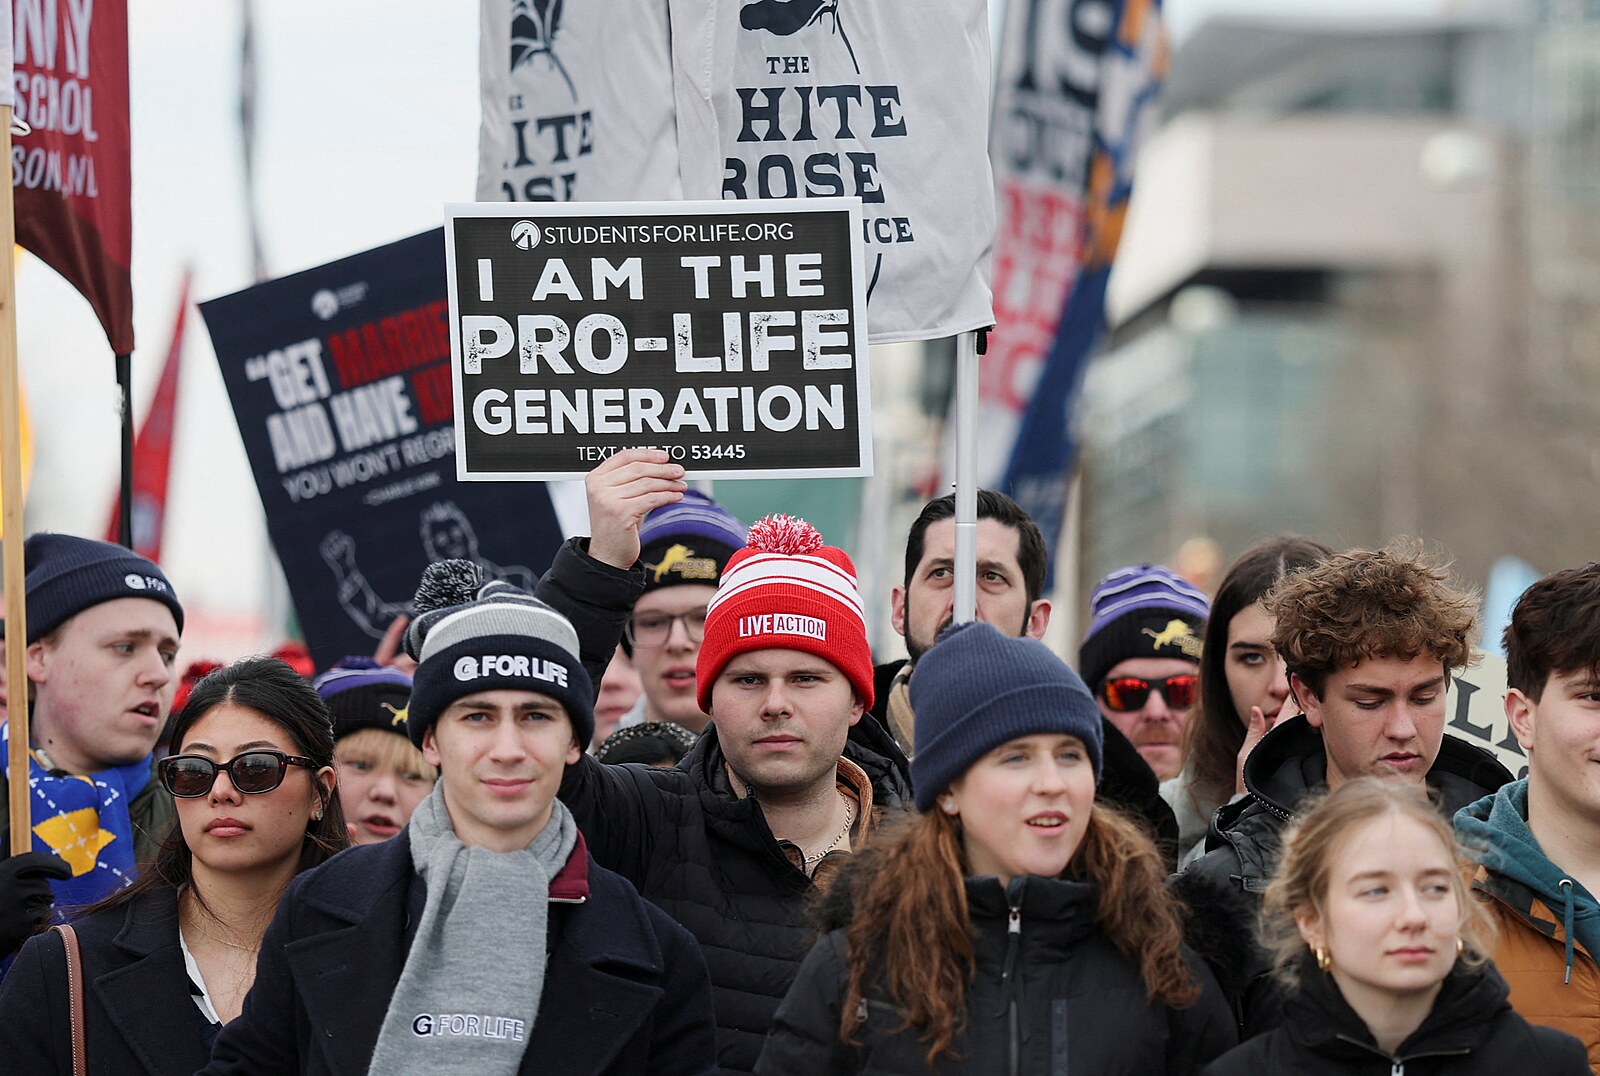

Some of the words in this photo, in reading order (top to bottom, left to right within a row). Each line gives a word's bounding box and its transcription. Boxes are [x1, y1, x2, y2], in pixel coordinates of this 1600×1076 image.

[766, 56, 810, 74] THE
[736, 85, 907, 142] HITE
[544, 223, 794, 244] STUDENTSFORLIFE.ORG
[477, 258, 494, 301] I
[531, 257, 644, 301] AM
[680, 253, 825, 299] THE
[461, 308, 852, 375] PRO-LIFE
[266, 403, 337, 474] AND
[330, 375, 419, 453] HAVE
[472, 384, 845, 435] GENERATION
[691, 444, 746, 459] 53445
[281, 464, 333, 503] YOU
[739, 614, 773, 638] LIVE
[774, 614, 826, 641] ACTION
[481, 655, 531, 676] FOR
[532, 657, 568, 688] LIFE
[437, 1014, 480, 1036] FOR
[482, 1015, 524, 1042] LIFE
